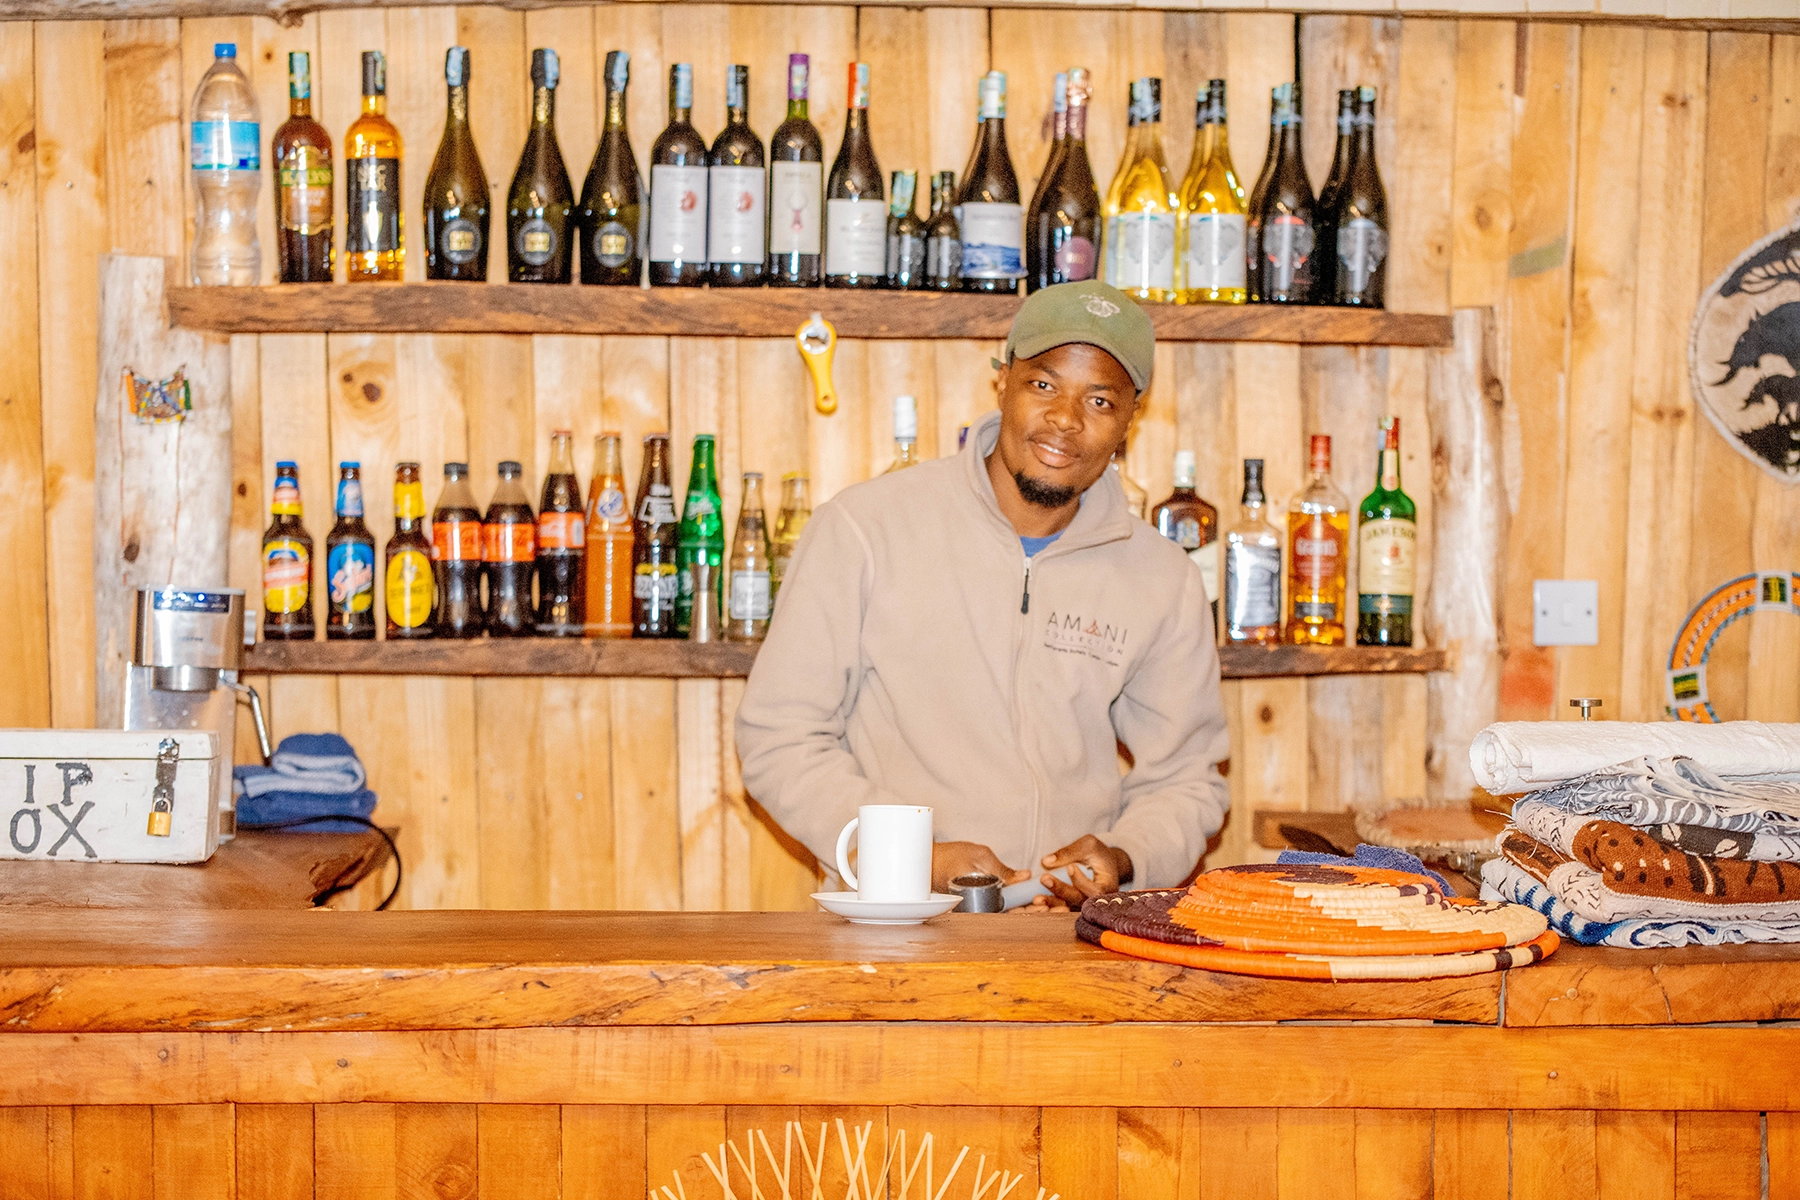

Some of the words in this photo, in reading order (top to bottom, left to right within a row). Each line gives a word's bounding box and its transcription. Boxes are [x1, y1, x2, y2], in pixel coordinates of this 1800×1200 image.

[1365, 527, 1416, 541] JAMESON
[1047, 611, 1128, 645] AMANI
[9, 800, 98, 859] OX
